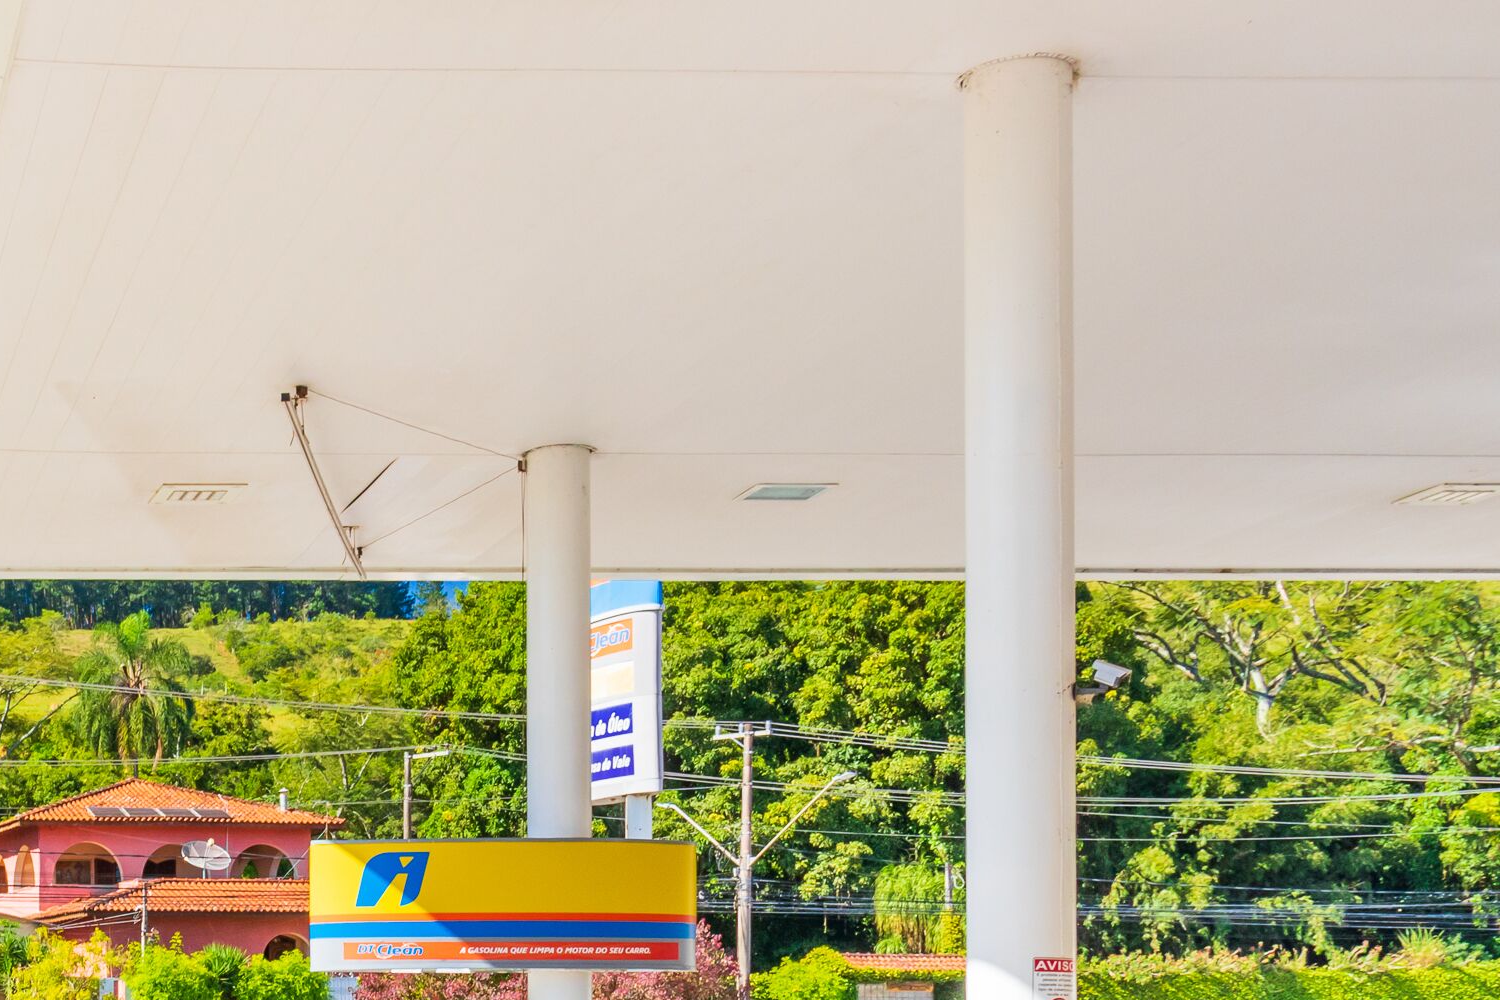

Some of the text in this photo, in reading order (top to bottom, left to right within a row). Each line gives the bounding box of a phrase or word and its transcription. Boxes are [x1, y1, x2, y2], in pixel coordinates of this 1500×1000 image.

[607, 712, 630, 734] Óleo
[377, 943, 424, 956] Clean
[459, 946, 651, 955] A GASOLINA QUE LIMPA O MOTOR DO SEU CARRO.
